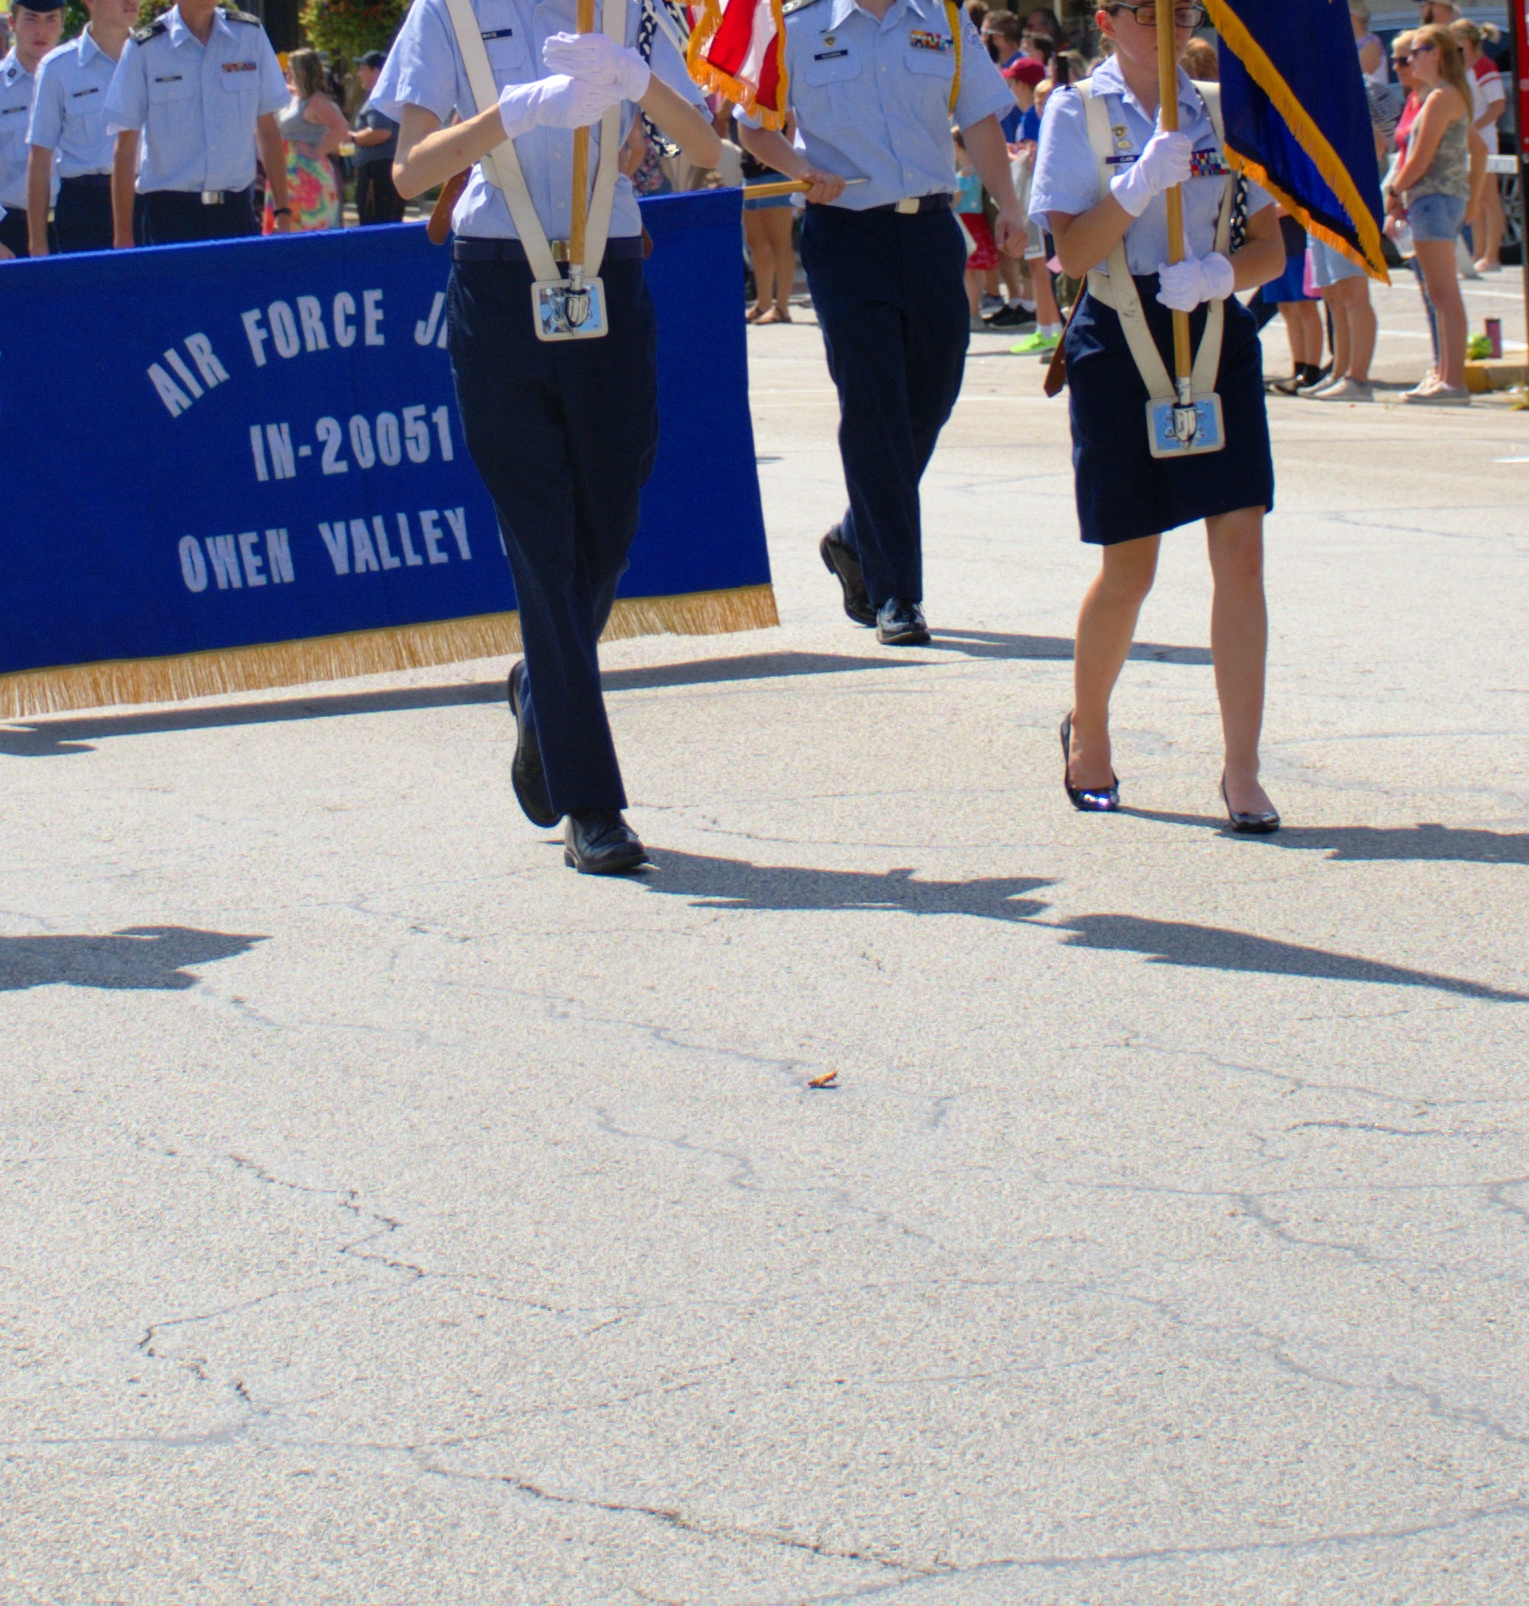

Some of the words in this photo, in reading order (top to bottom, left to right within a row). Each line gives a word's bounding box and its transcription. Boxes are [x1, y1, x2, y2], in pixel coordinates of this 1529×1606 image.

[146, 331, 231, 418] AIR
[240, 288, 386, 368] FORCE
[249, 404, 454, 482] IN-20051
[178, 527, 295, 593] OWEN
[318, 506, 473, 576] VALLEY
